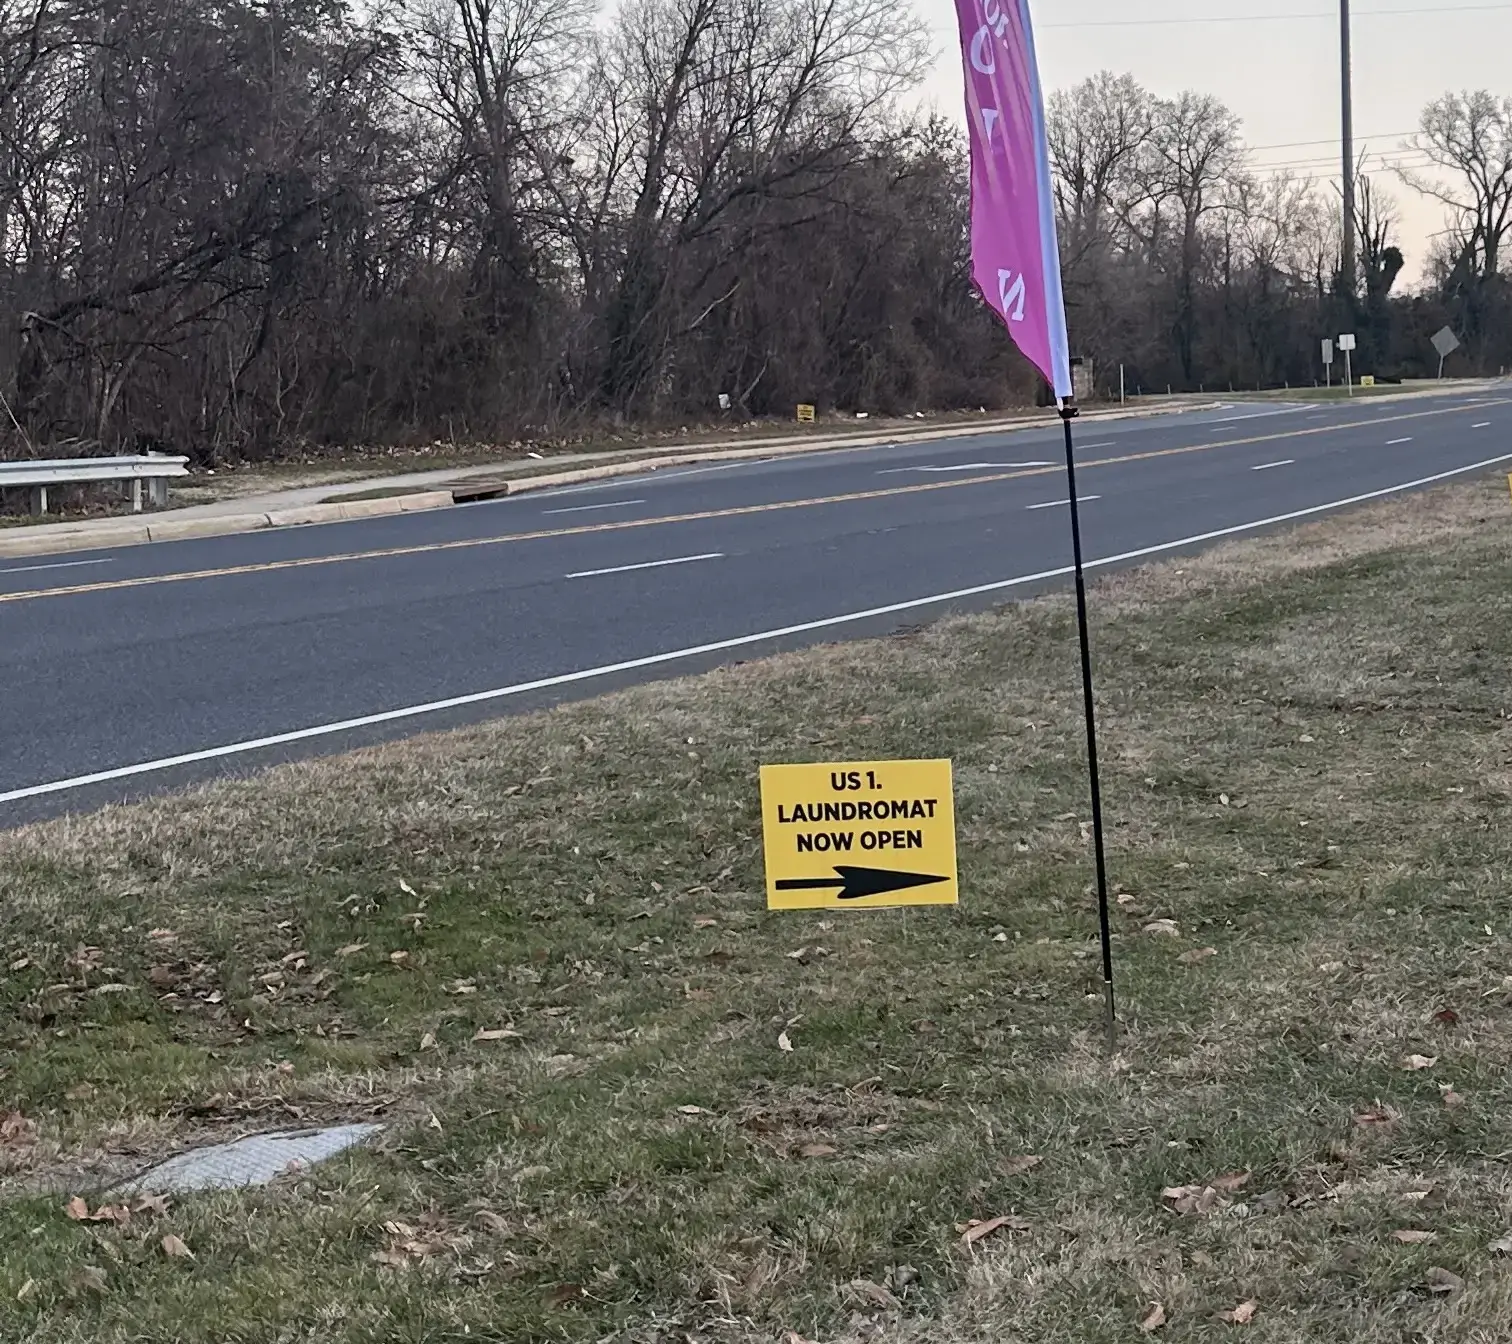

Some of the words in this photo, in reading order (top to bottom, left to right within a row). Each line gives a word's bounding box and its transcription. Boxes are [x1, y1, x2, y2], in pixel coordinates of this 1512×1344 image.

[831, 771, 861, 791] US
[866, 770, 882, 790] 1.
[778, 799, 938, 823] LAUNDROMAT
[797, 832, 854, 852] NOW
[860, 830, 922, 850] OPEN
